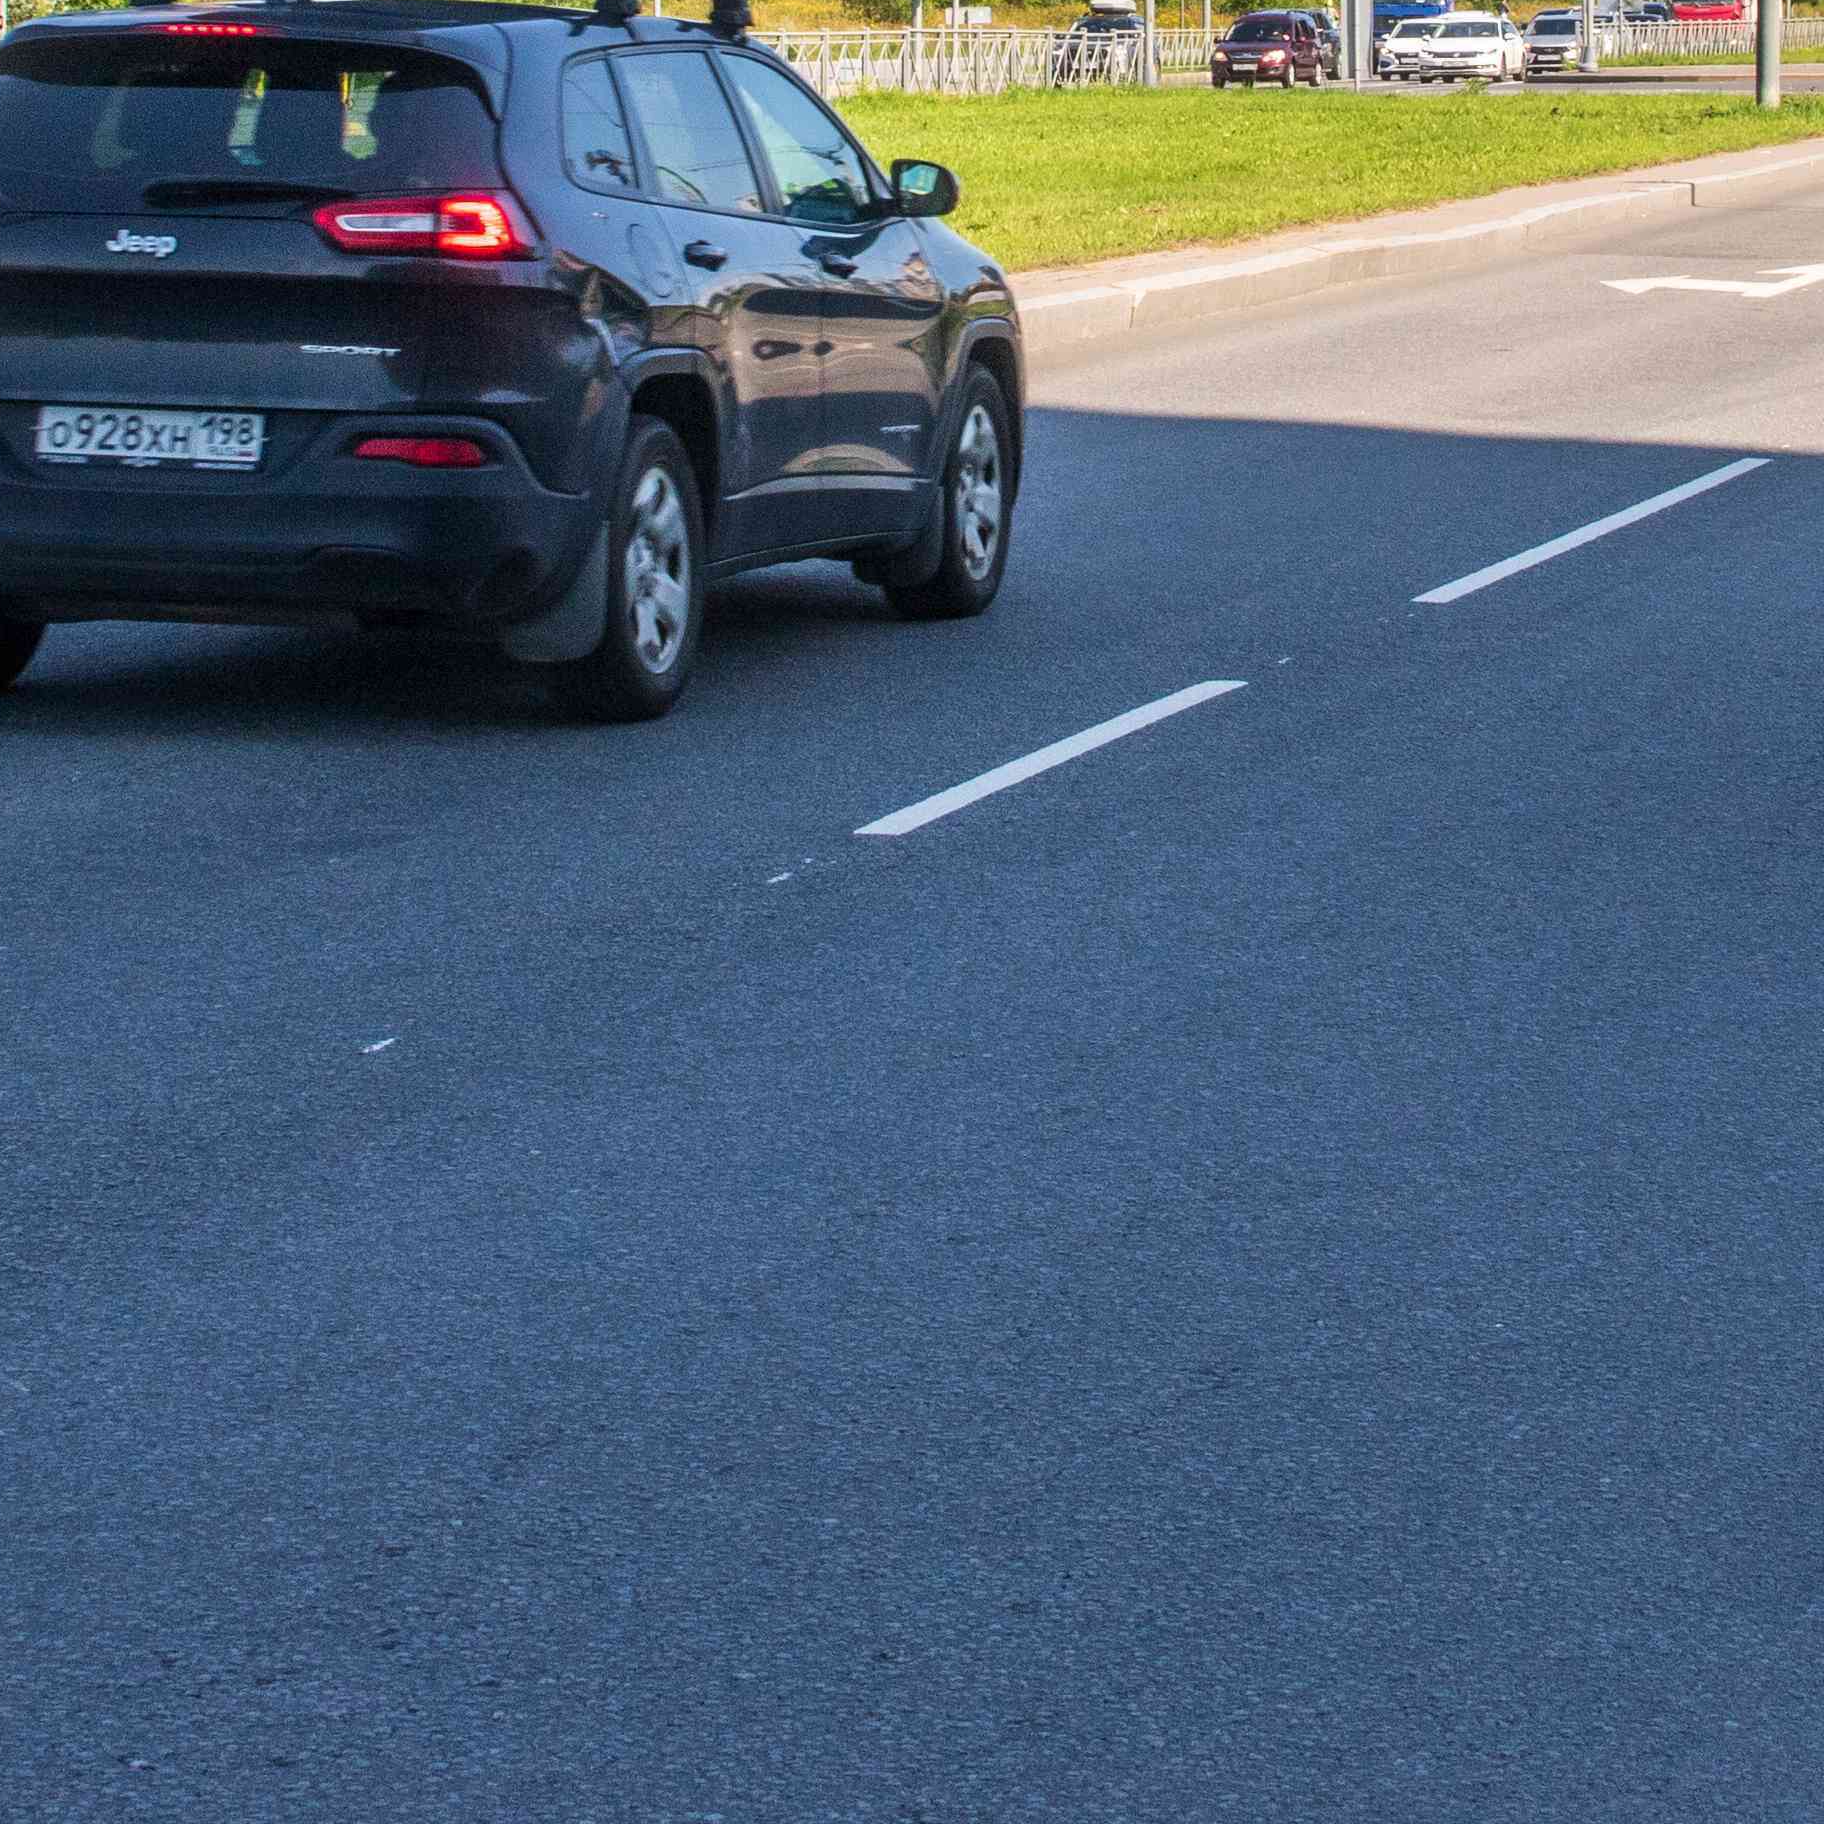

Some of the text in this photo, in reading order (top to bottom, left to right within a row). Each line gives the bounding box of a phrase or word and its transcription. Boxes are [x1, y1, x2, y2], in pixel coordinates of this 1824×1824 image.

[105, 229, 178, 258] Jeep
[300, 344, 402, 357] SPORT
[49, 413, 255, 453] О928ХН 198
